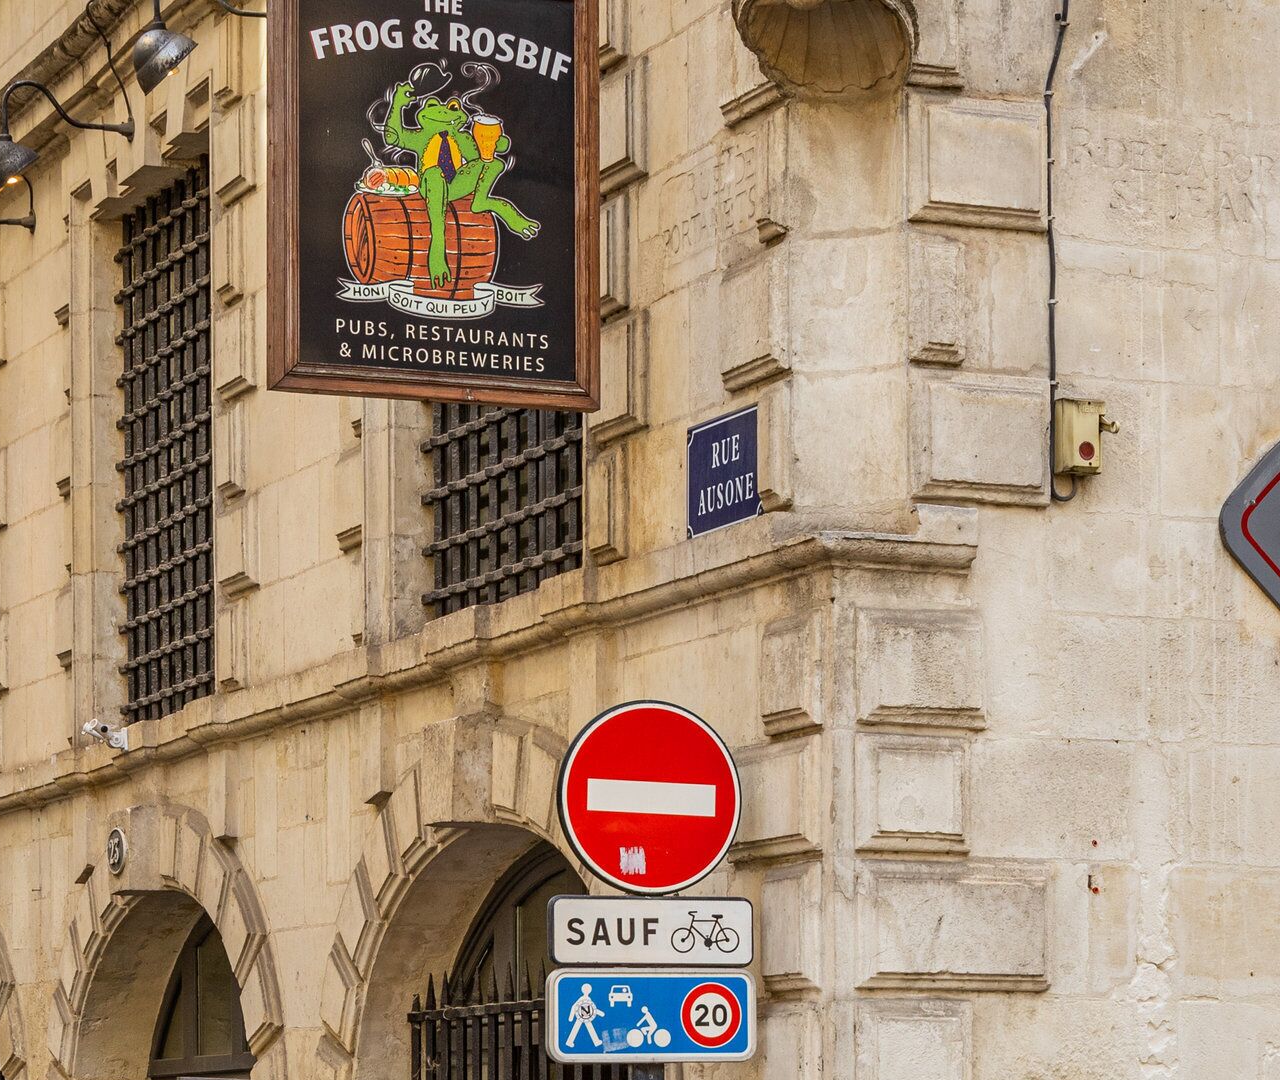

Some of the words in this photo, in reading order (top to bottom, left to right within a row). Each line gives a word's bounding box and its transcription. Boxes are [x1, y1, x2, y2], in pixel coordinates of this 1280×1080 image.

[309, 18, 404, 60] FROG
[413, 19, 439, 50] &
[449, 22, 572, 83] ROSBIF
[352, 285, 385, 298] HONI
[391, 294, 422, 312] SOIT
[426, 302, 448, 315] QUI
[452, 302, 478, 315] PEU
[481, 298, 490, 312] Y
[496, 289, 526, 303] BOIT
[335, 318, 395, 341] PUBS,
[405, 324, 550, 350] RESTAURANTS
[339, 341, 351, 358] &
[362, 344, 545, 372] MICROBREWERIES
[711, 434, 740, 468] RUE
[698, 472, 754, 516] AUSONE
[566, 917, 659, 946] SAUF
[694, 1003, 728, 1027] 20
